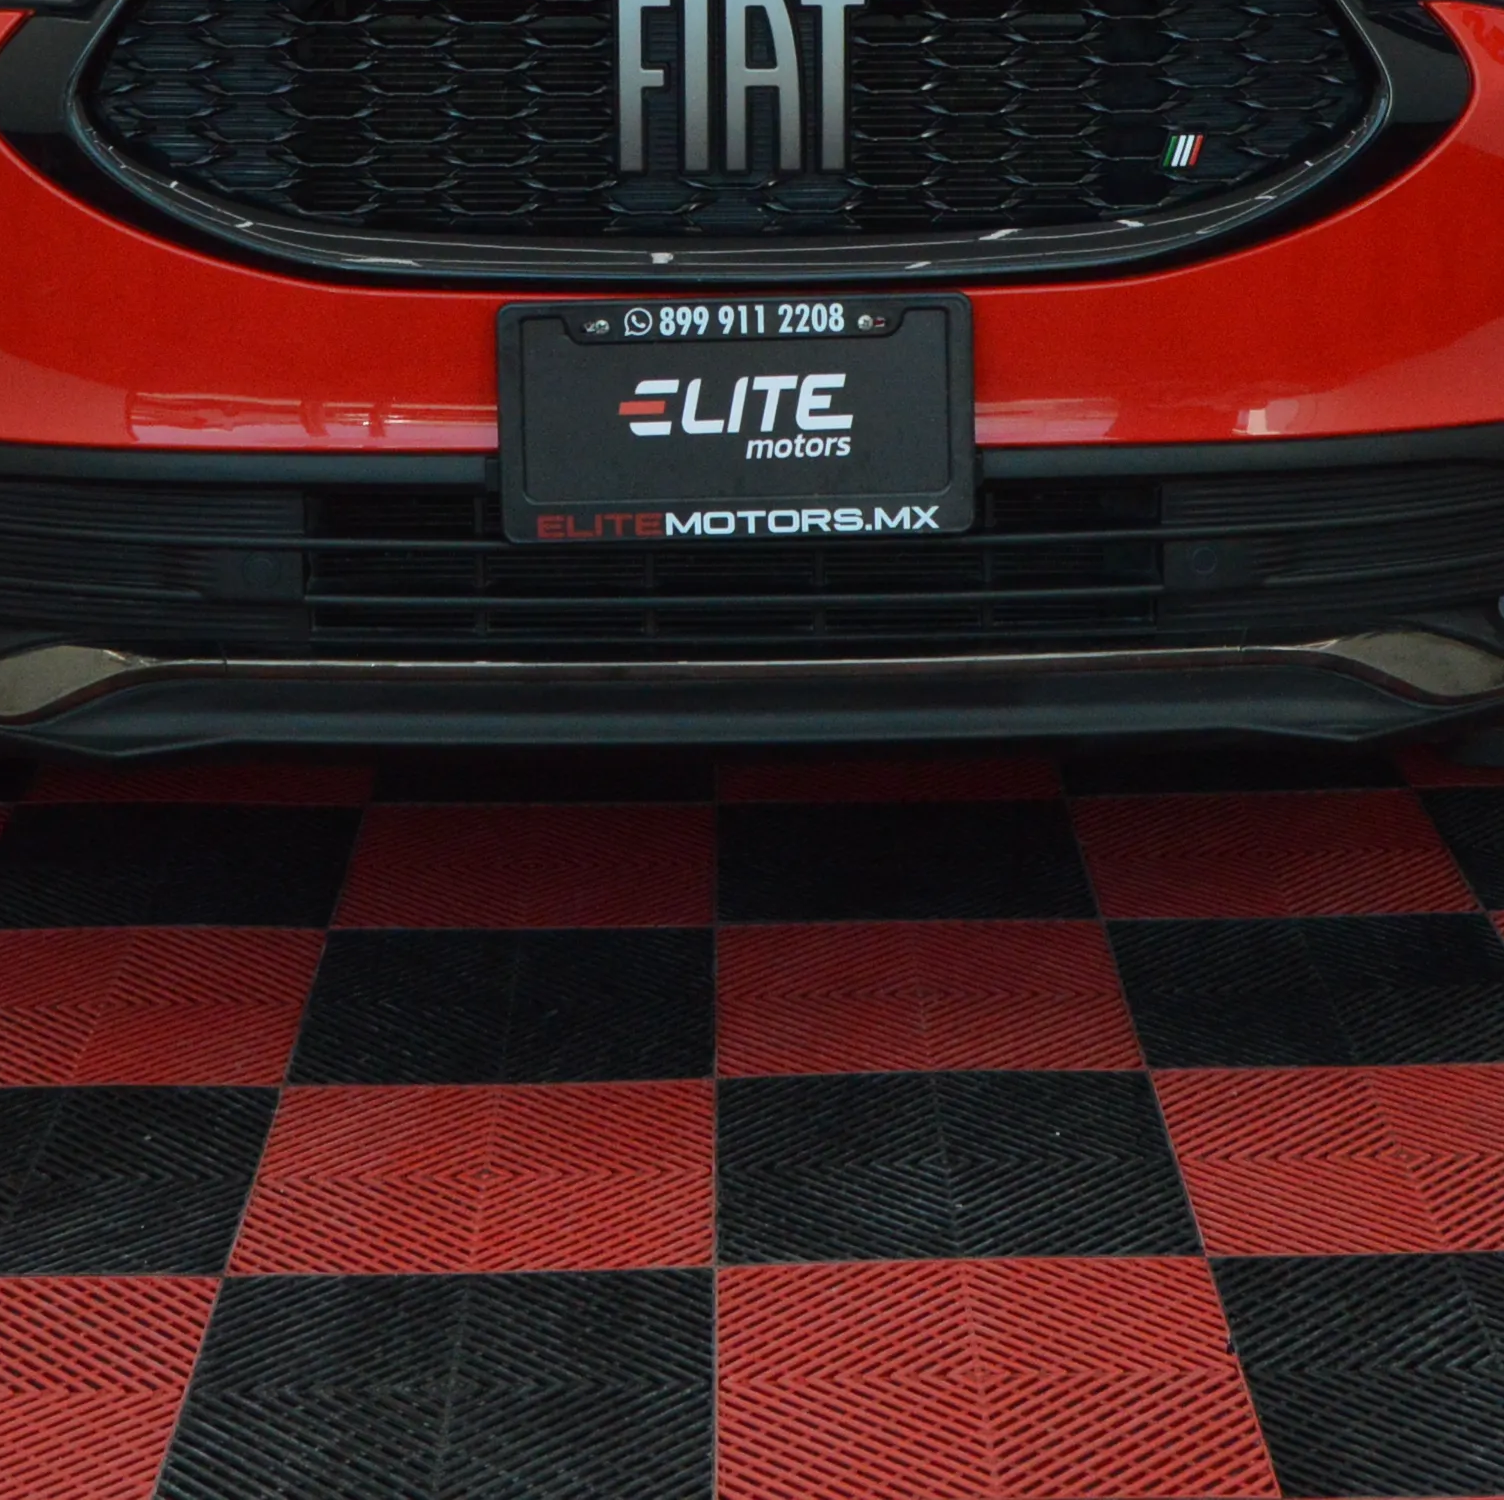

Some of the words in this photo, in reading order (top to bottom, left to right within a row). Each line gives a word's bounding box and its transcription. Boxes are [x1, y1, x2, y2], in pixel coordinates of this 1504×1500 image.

[660, 307, 710, 336] 899
[718, 305, 766, 334] 911
[778, 303, 845, 334] 2208
[618, 373, 854, 436] ELITE
[746, 434, 851, 459] motors
[536, 506, 940, 539] ELITEMOTORS.MX
